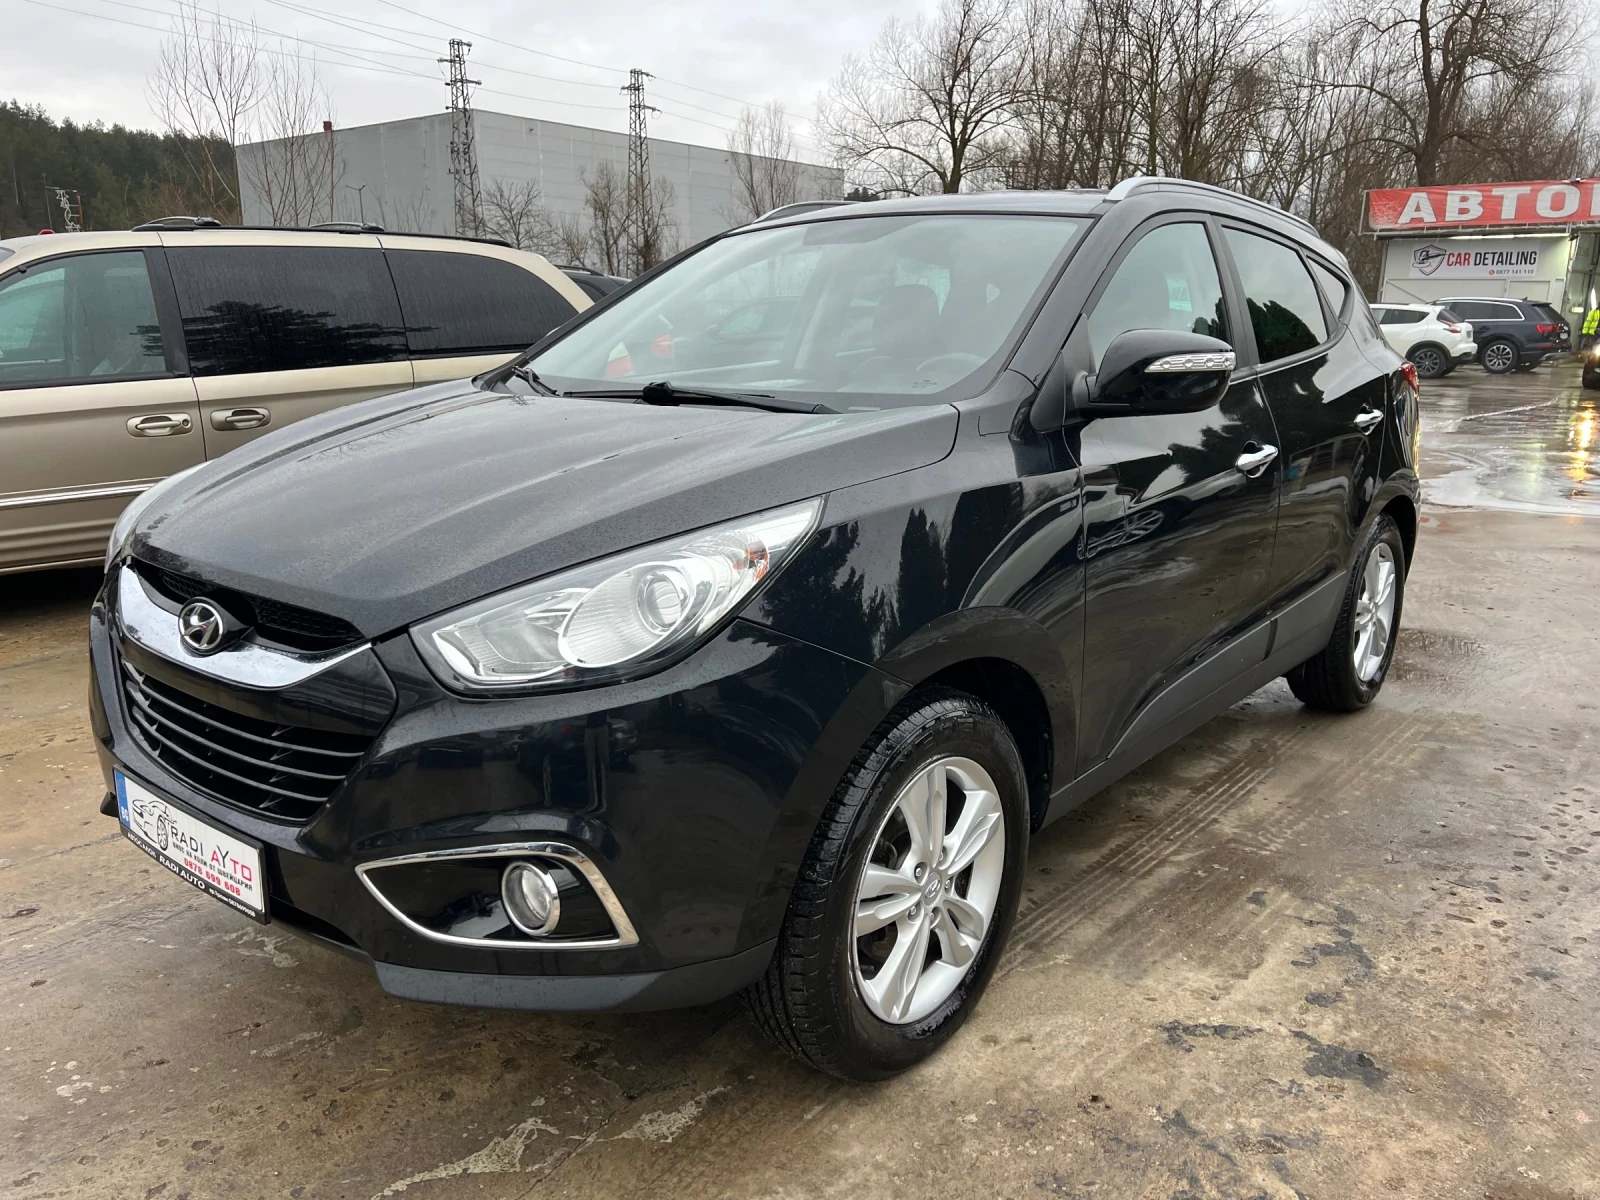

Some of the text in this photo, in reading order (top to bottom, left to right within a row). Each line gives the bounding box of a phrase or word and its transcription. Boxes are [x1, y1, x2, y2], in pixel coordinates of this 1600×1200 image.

[1397, 184, 1600, 224] АВТО
[1446, 251, 1537, 267] CAR DETAILING
[121, 806, 129, 822] BG
[170, 825, 204, 856] RADI
[159, 856, 205, 889] RADI AUTO
[184, 858, 241, 896] 0878 699 608
[186, 849, 193, 859] НА
[194, 853, 208, 868] КОЛИ
[209, 863, 216, 872] ОТ
[217, 867, 253, 891] ШВЕЙЦАРИЯ
